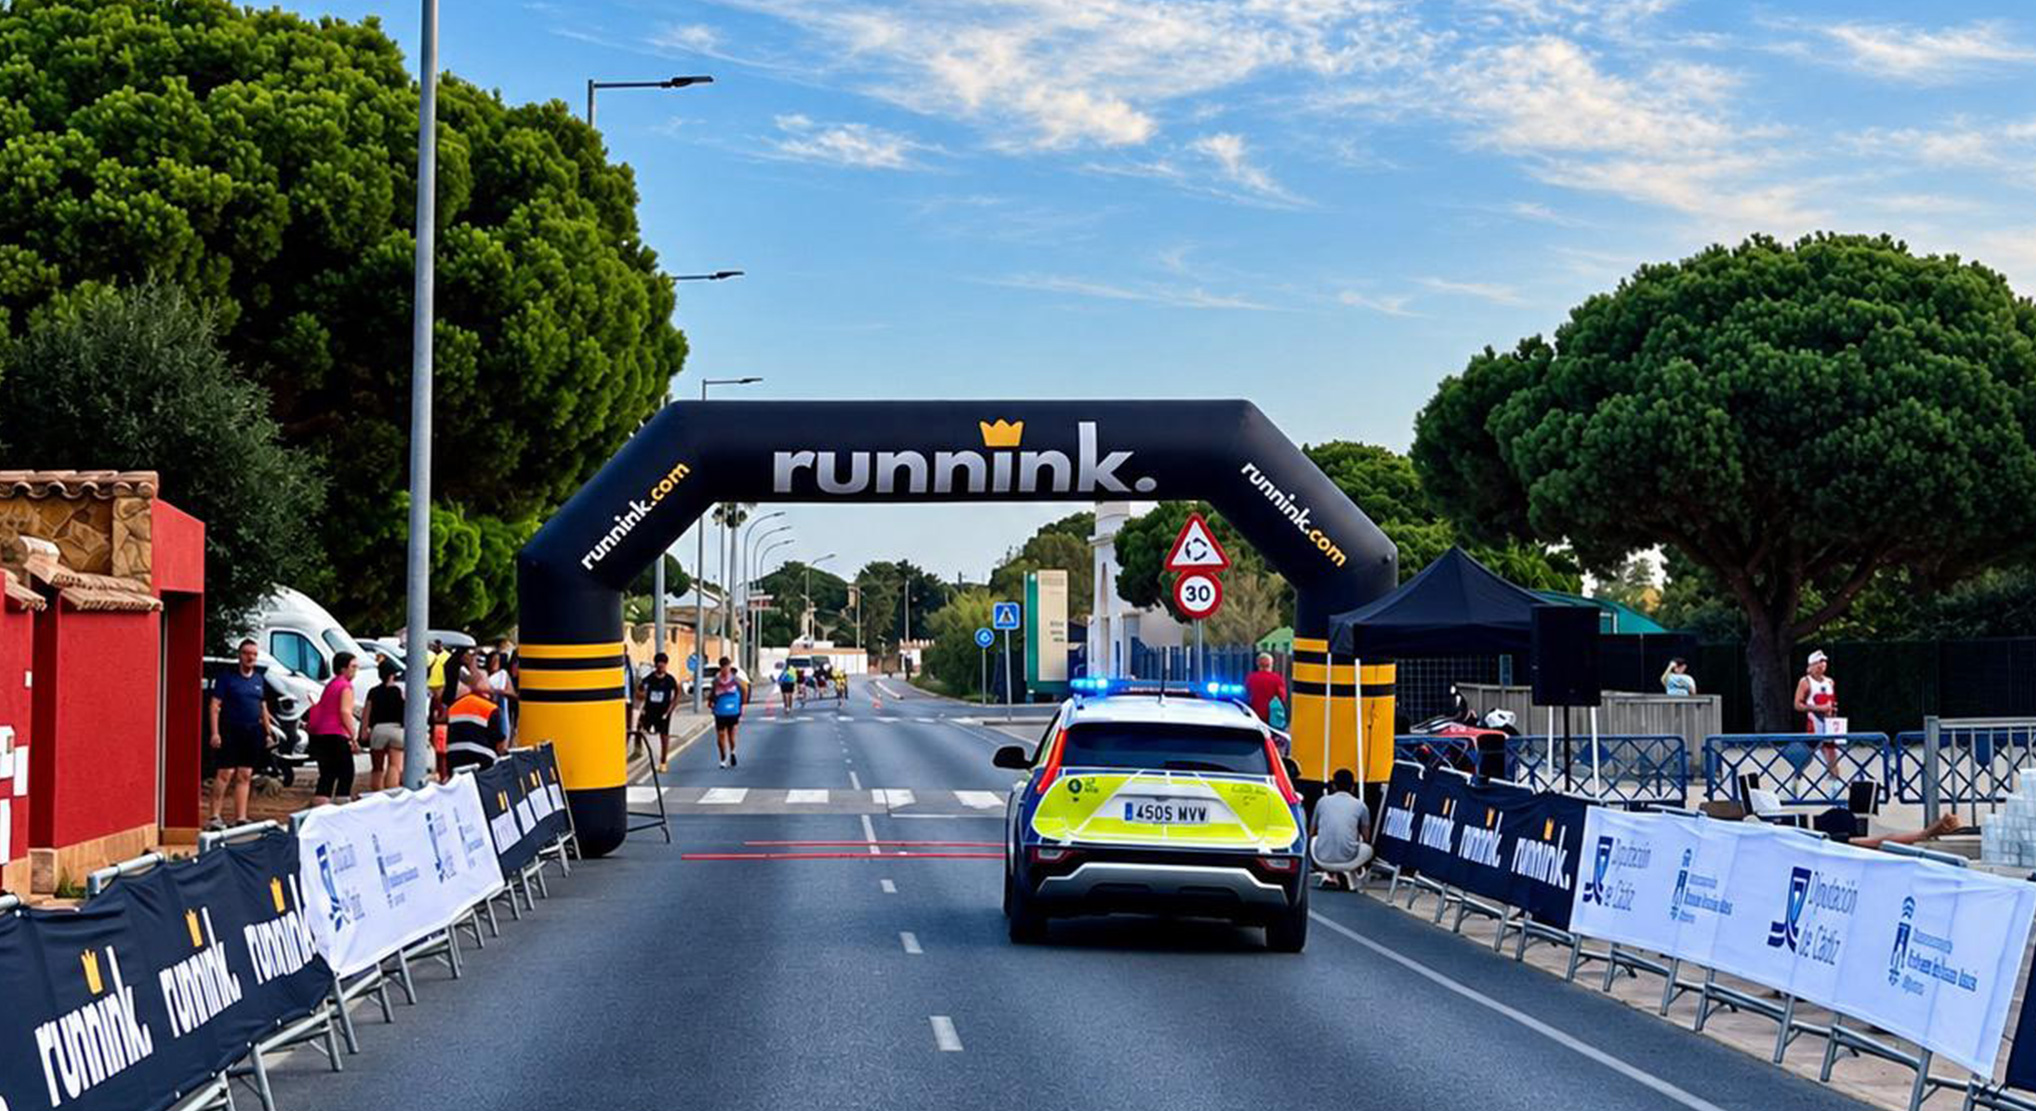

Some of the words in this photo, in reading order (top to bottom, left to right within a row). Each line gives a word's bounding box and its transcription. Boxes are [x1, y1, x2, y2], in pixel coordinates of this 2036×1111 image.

[773, 420, 1157, 494] runnink.
[581, 463, 690, 570] runnink.com
[1241, 462, 1347, 567] runnink.com
[1185, 585, 1211, 602] 30
[243, 873, 318, 985] runnink
[1808, 870, 1859, 917] Diputación
[157, 907, 243, 1038] runnink.
[34, 945, 153, 1108] runnink.
